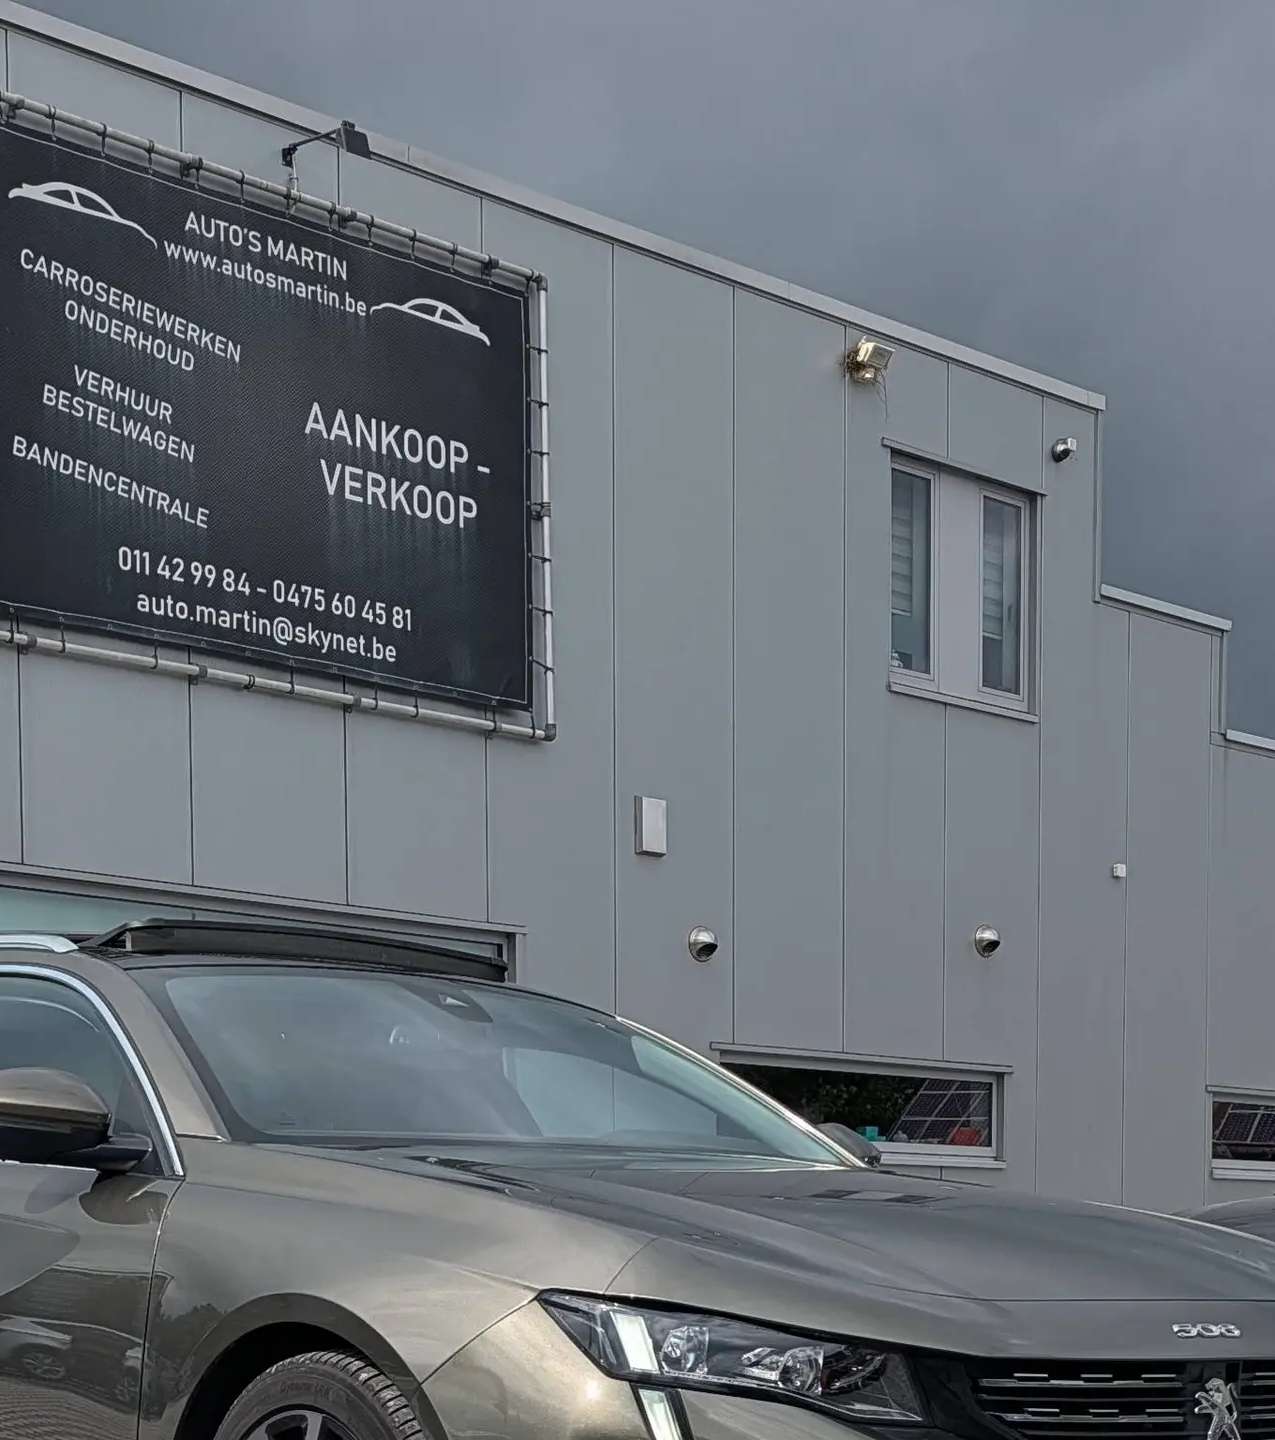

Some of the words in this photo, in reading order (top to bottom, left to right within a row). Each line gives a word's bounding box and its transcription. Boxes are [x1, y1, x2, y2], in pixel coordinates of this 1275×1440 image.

[164, 240, 367, 316] www.autosmartin.be
[185, 211, 262, 251] AUTO'S
[267, 236, 347, 280] MARTIN
[20, 249, 241, 363] CARROSERIEWERKEN
[65, 300, 194, 371] ONDERHOUD
[43, 384, 195, 463] BESTELWAGEN
[75, 364, 173, 424] VERHUUR
[305, 402, 468, 473] AANKOOP
[13, 435, 209, 529] BANDENCENTRALE
[320, 459, 477, 528] VERKOOP
[118, 546, 150, 575] 011
[157, 555, 185, 582] 42
[190, 561, 216, 588] 99
[223, 568, 250, 596] 84
[273, 579, 326, 611] 0475
[331, 593, 356, 618] 60
[362, 600, 386, 625] 45
[392, 606, 412, 631] 81
[137, 592, 397, 663] auto.martin@skynet.be
